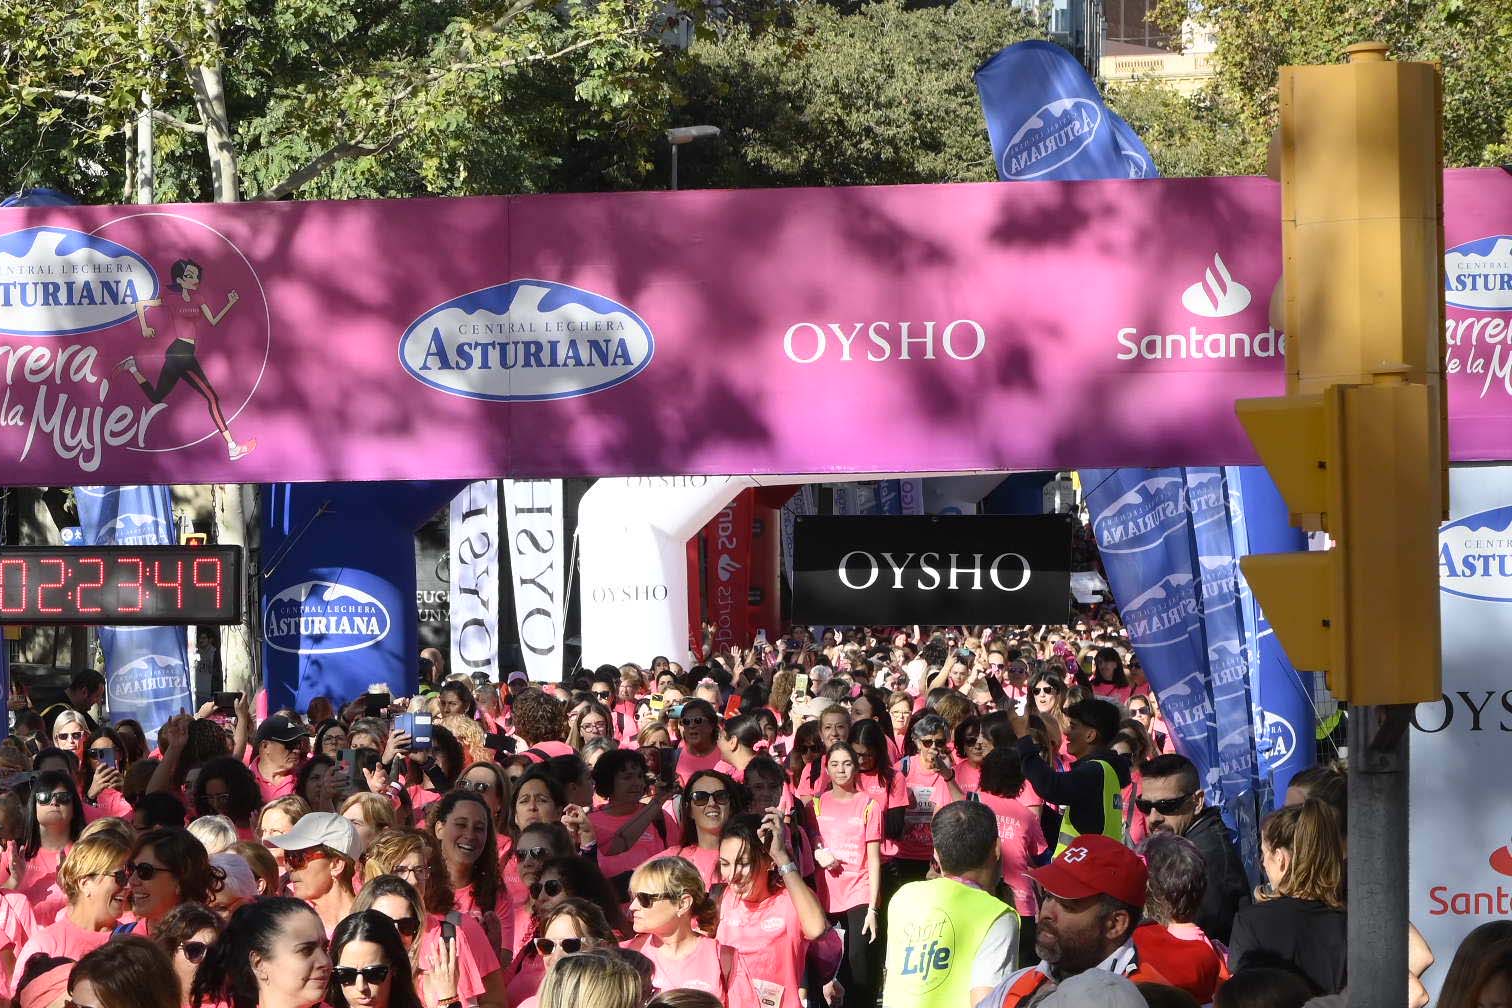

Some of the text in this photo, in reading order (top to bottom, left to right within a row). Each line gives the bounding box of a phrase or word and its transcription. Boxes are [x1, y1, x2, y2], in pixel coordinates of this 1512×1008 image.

[61, 263, 134, 275] LECHERA
[458, 320, 626, 336] CENTRAL LECHERA
[783, 319, 987, 364] OYSHO
[419, 327, 635, 371] ASTURIANA
[0, 384, 25, 427] la
[20, 380, 168, 472] Mujer
[0, 558, 221, 612] 02:23:49
[838, 550, 1032, 592] OYSHO
[268, 610, 381, 638] ASTURIANA
[280, 605, 376, 614] CENTRAL LECHERA
[901, 940, 951, 981] Life
